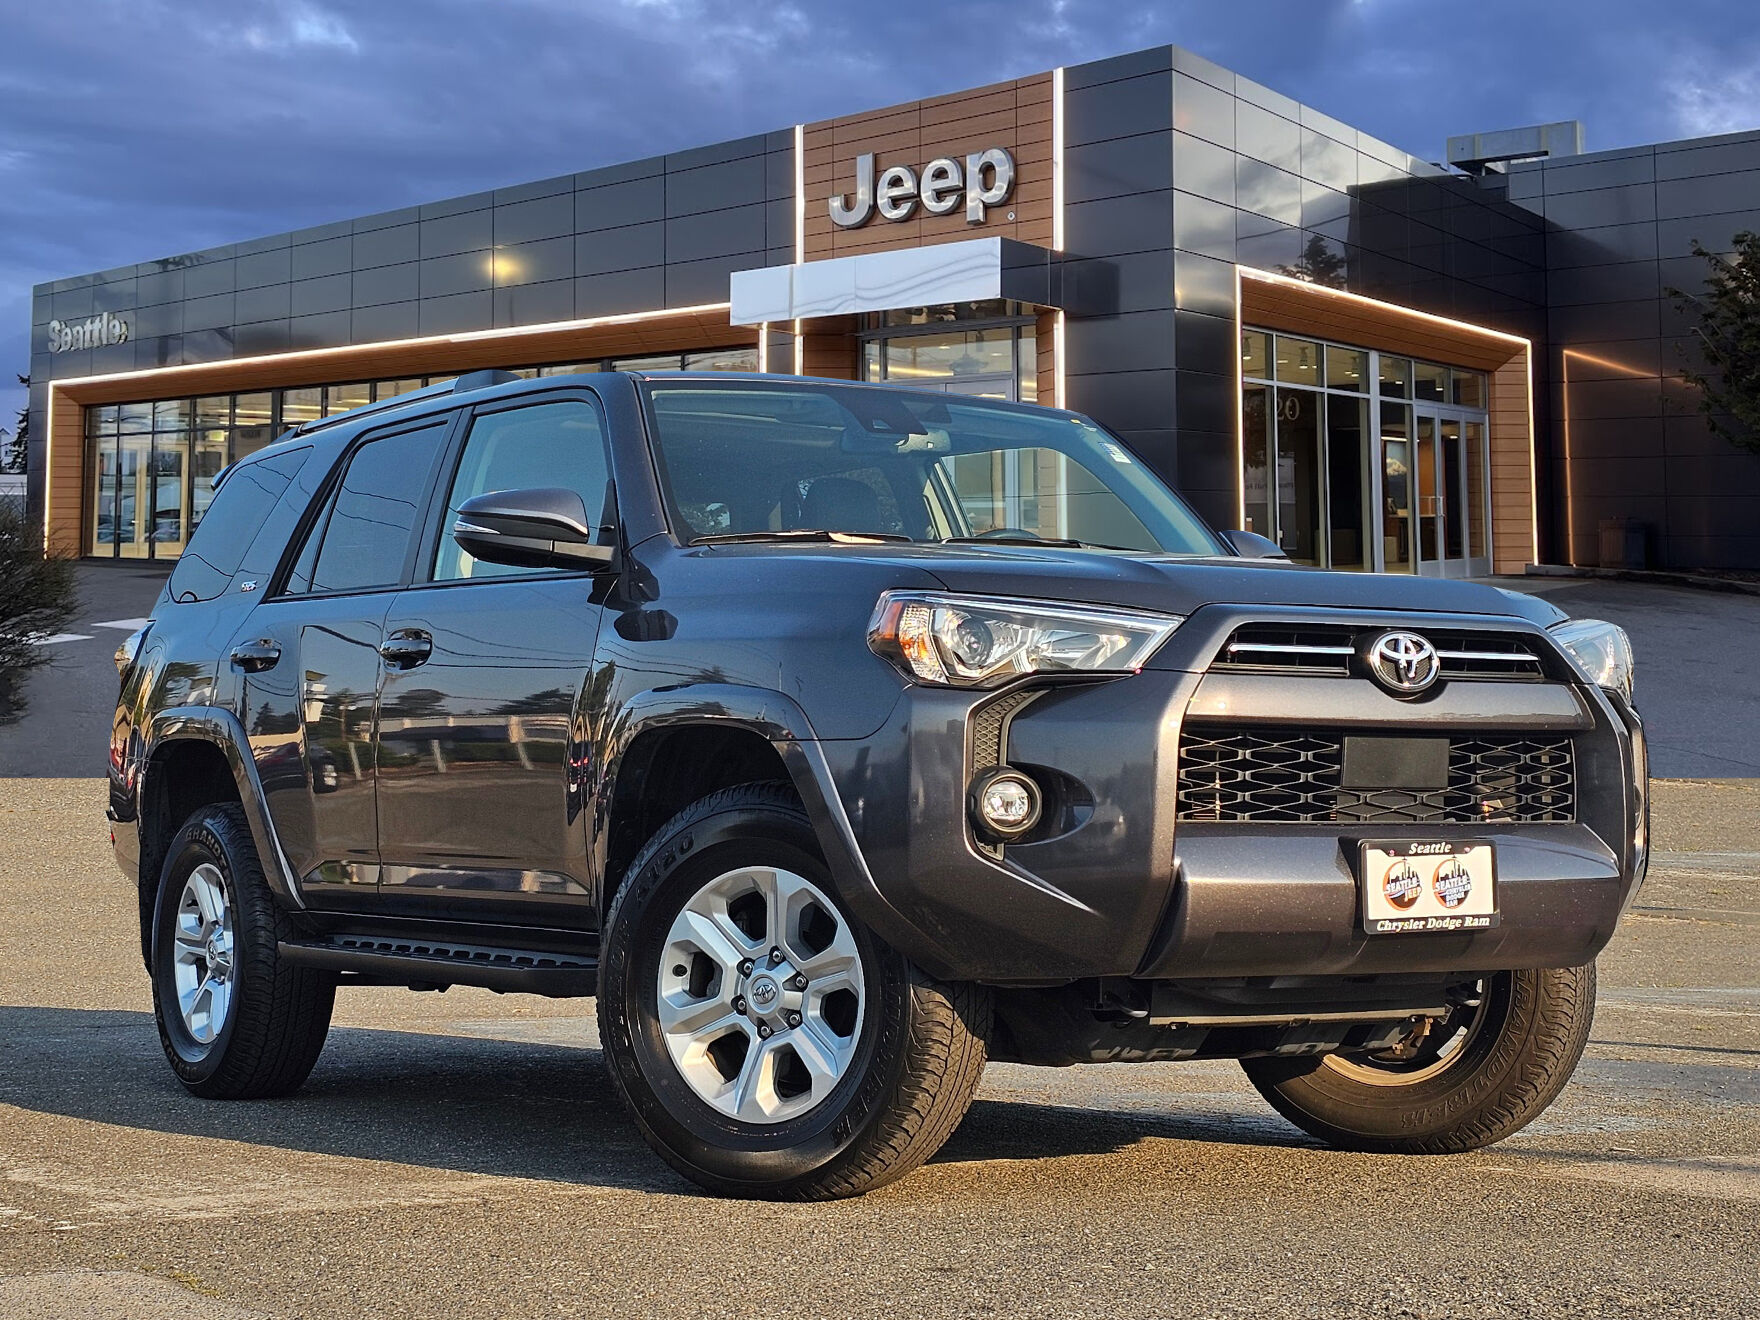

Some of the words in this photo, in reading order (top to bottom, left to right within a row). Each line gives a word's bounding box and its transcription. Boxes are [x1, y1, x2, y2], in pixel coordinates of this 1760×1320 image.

[828, 148, 1016, 229] Jeep
[48, 312, 127, 353] Seattle
[1408, 842, 1452, 855] Seattle
[1377, 919, 1426, 932] Chrysler
[1426, 917, 1463, 930] Dodge
[1464, 916, 1490, 927] Ram
